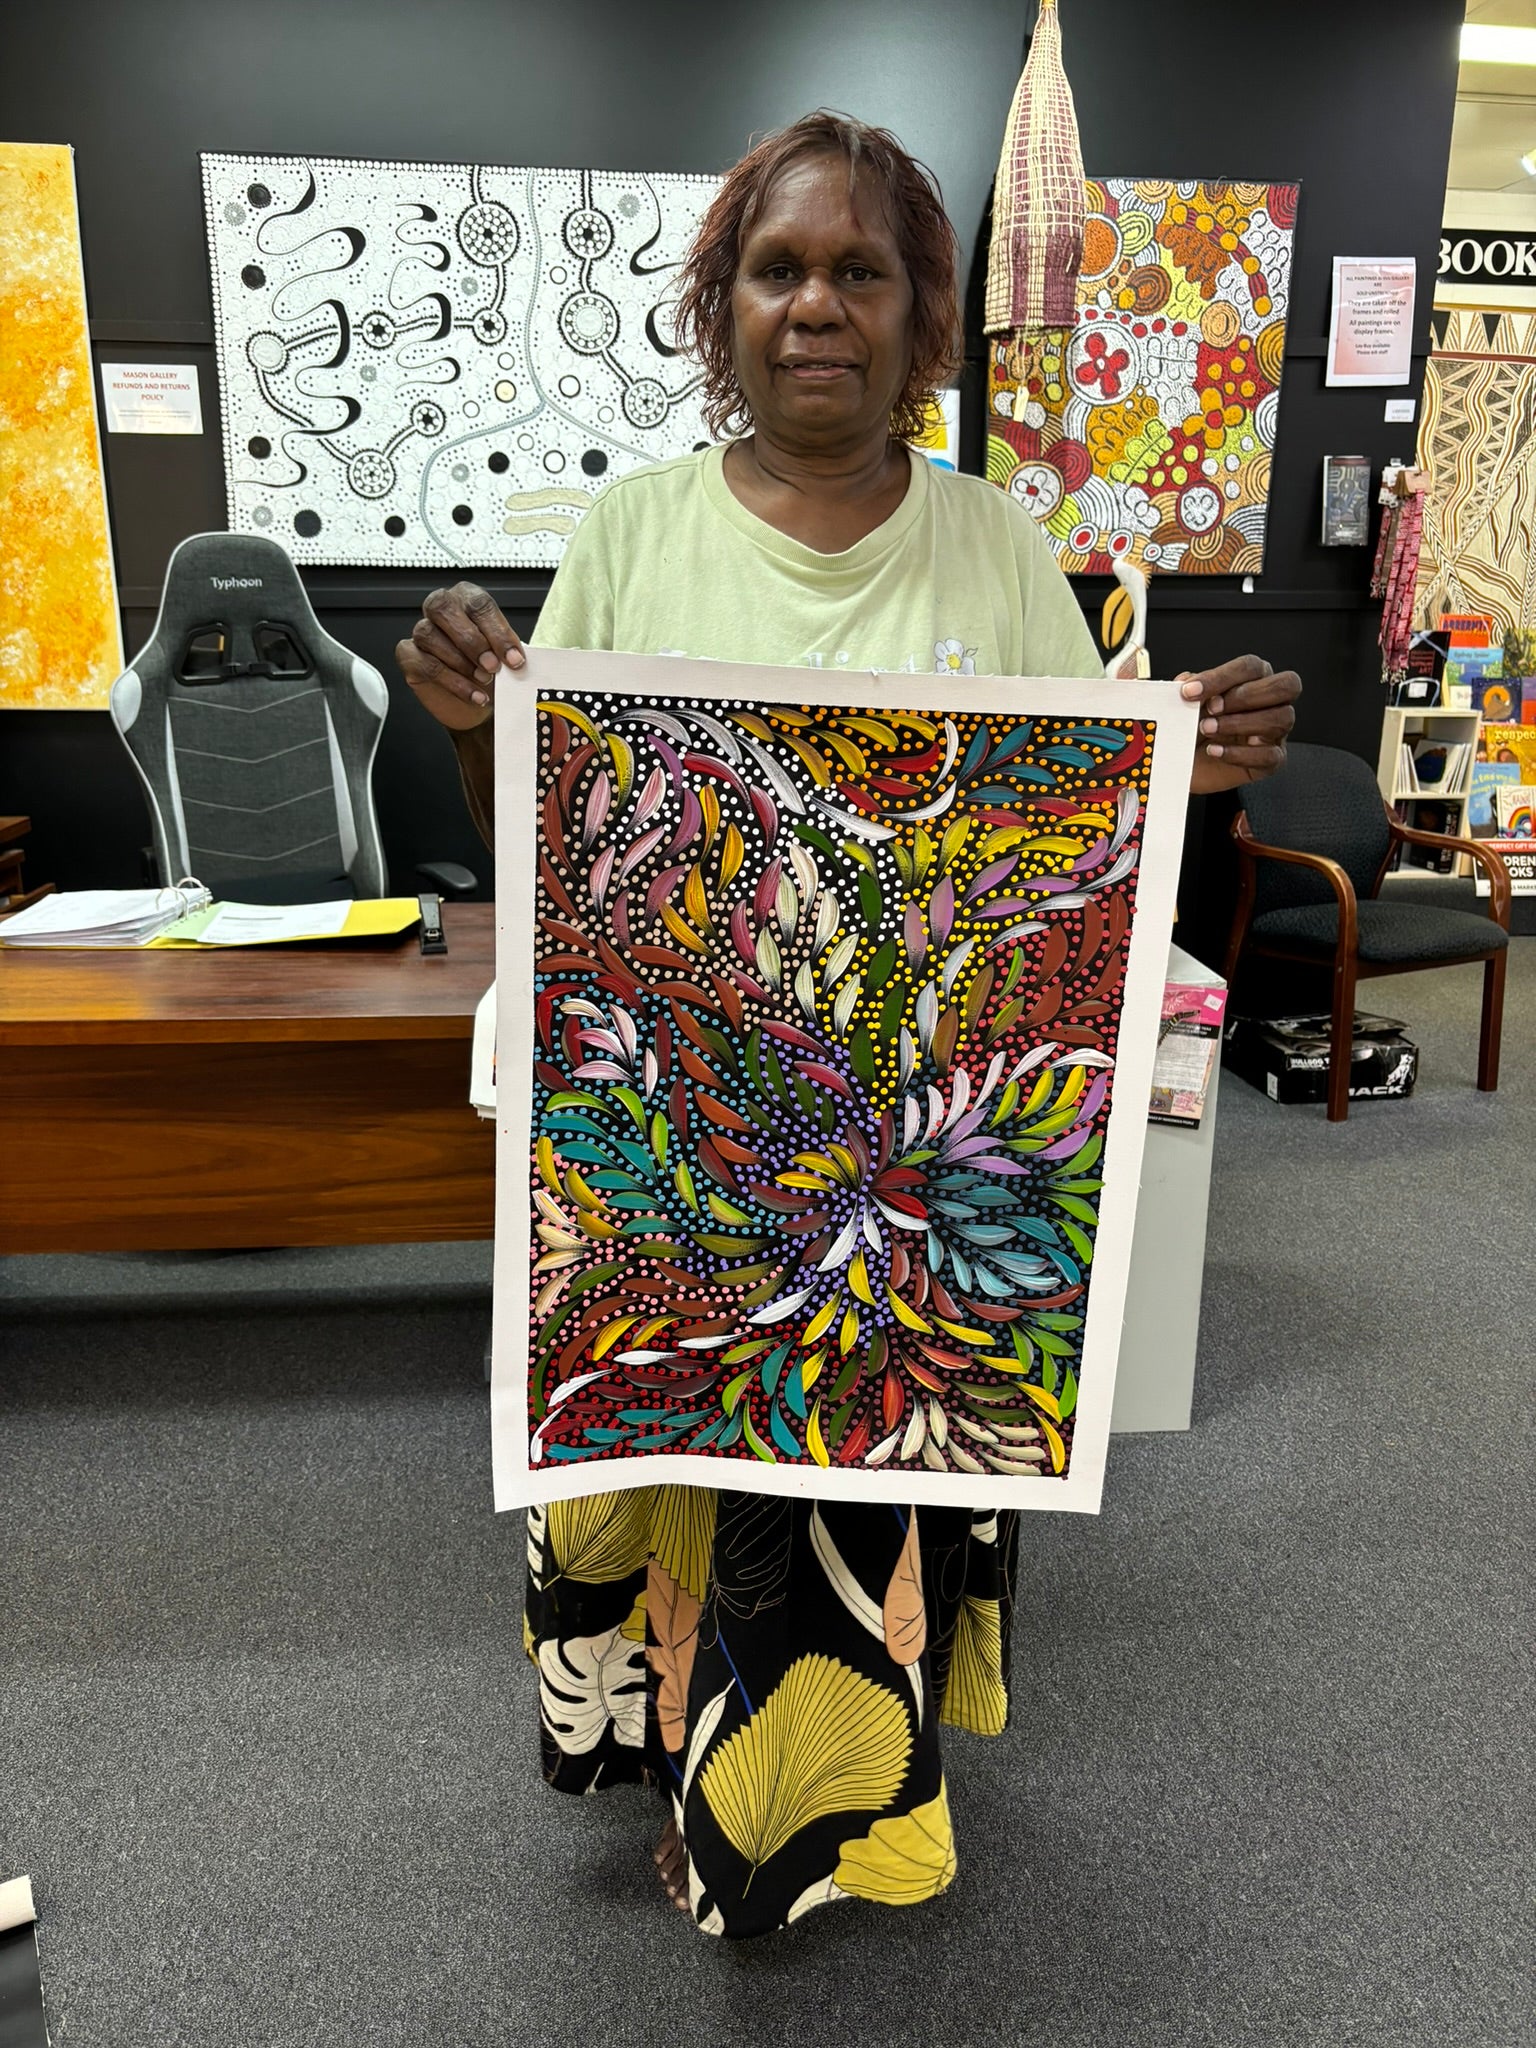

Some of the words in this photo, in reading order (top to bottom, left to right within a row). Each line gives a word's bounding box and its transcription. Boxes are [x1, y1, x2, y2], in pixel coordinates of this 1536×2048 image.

[210, 576, 263, 590] Typhoon
[1503, 855, 1536, 867] DREN
[1508, 866, 1534, 878] OKS
